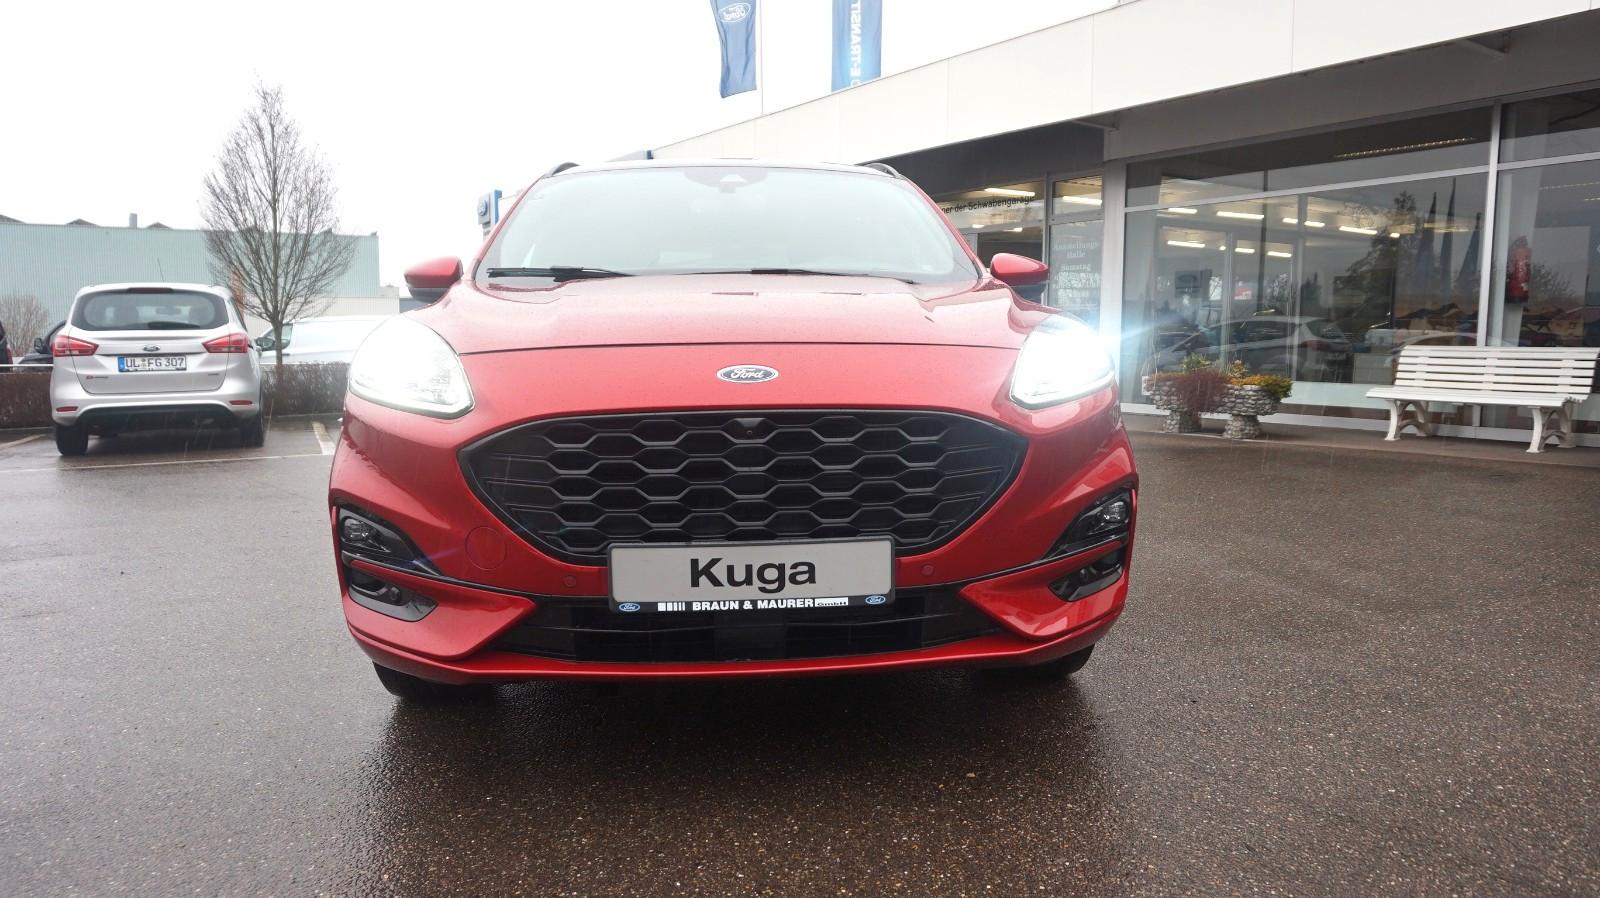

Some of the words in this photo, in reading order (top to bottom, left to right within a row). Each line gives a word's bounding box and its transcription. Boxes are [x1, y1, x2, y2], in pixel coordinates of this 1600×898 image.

[941, 206, 953, 214] ner
[955, 203, 966, 212] der
[125, 359, 140, 368] UL
[148, 358, 162, 368] FG
[164, 357, 184, 367] 307
[690, 557, 817, 594] Kuga
[692, 600, 740, 611] BRAUN
[742, 600, 753, 610] &
[757, 598, 814, 609] MAURER
